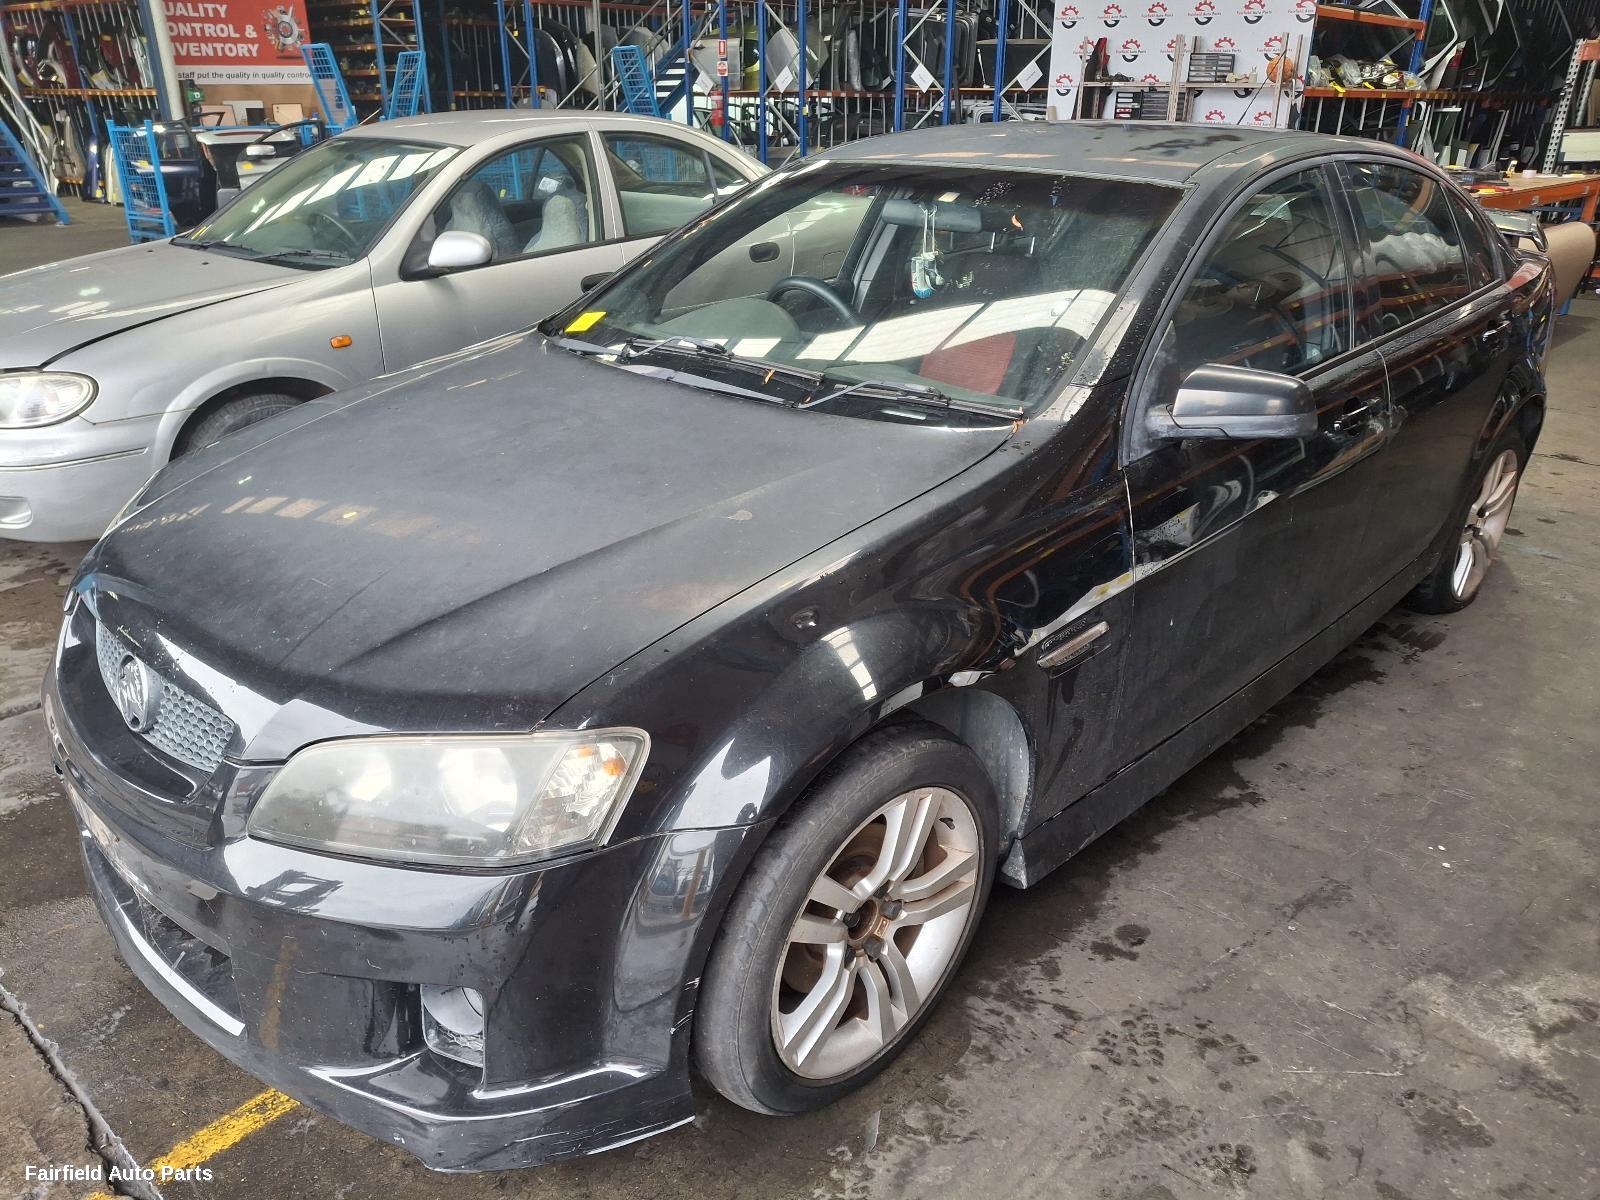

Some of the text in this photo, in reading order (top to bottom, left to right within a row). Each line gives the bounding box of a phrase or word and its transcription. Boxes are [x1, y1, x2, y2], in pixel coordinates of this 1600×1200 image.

[163, 2, 228, 18] UALITY
[166, 22, 258, 38] ONTROL &
[177, 71, 195, 79] staff
[197, 72, 209, 81] put
[212, 71, 224, 79] the
[226, 71, 250, 81] quality
[261, 72, 284, 80] quality
